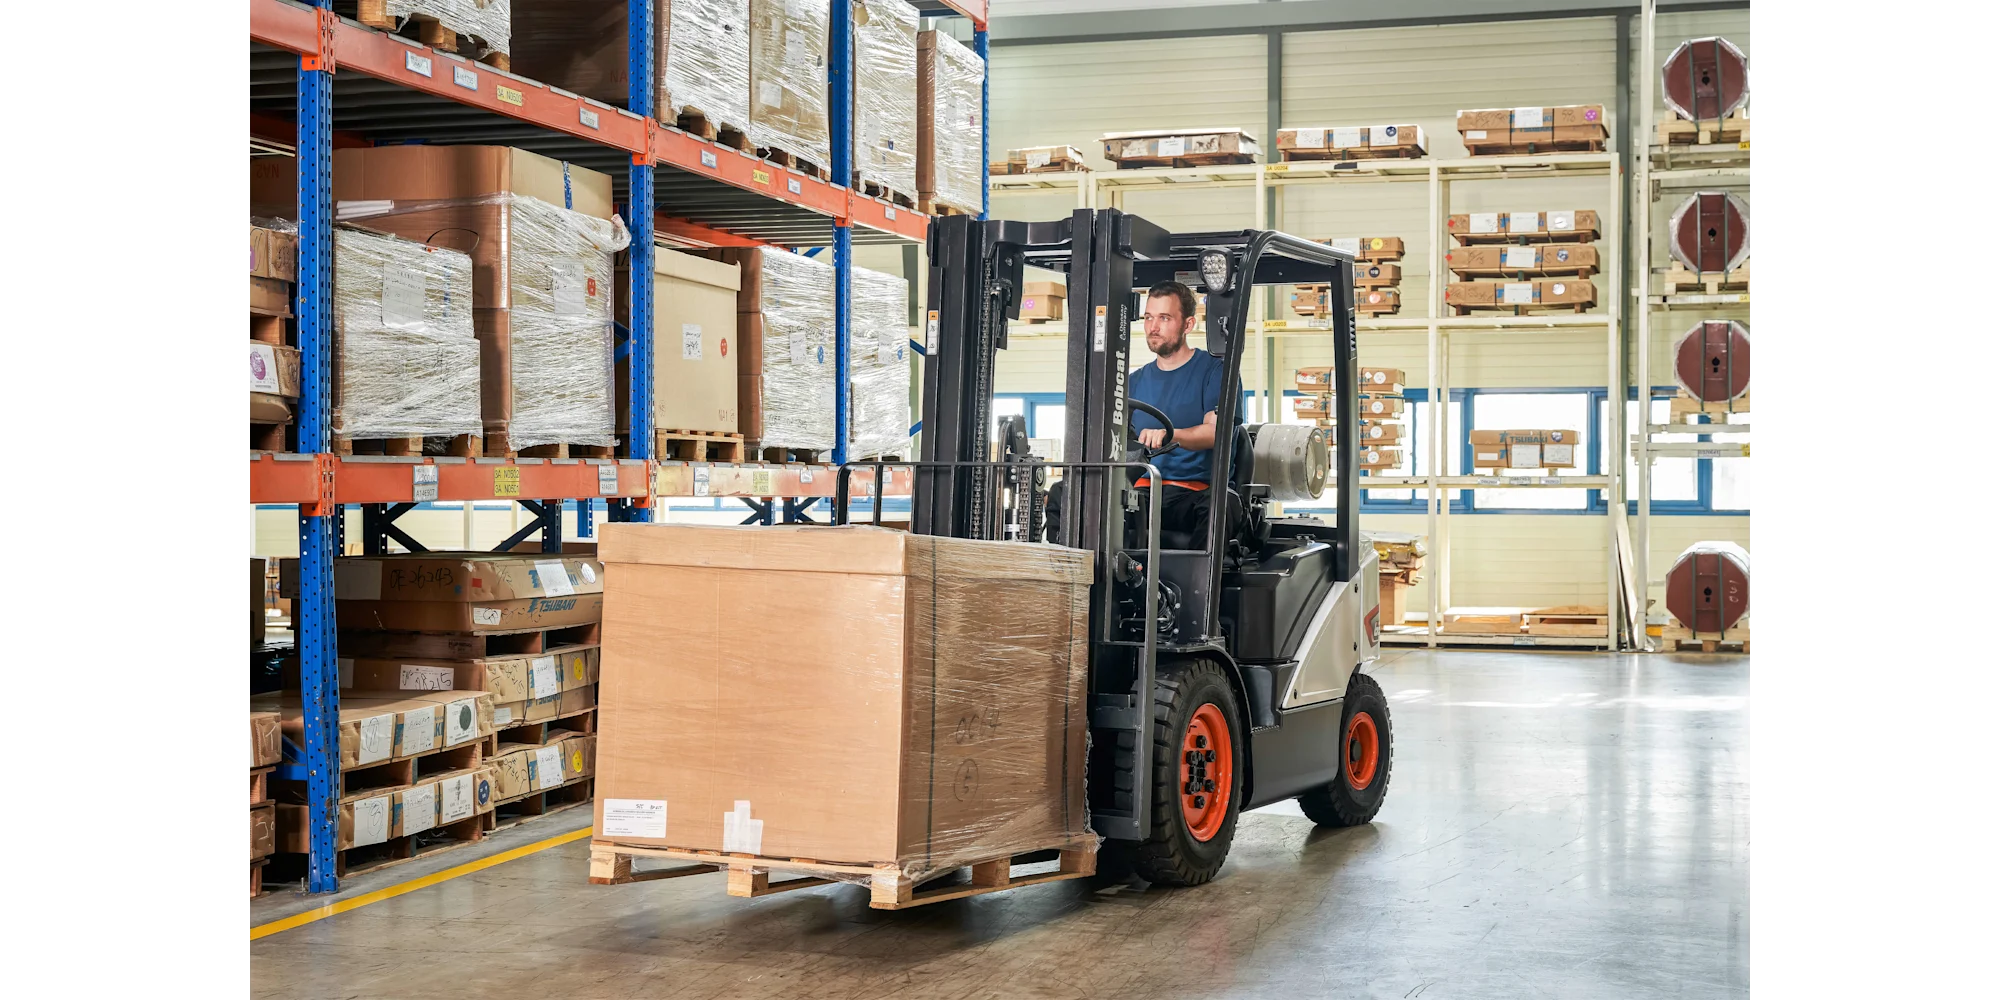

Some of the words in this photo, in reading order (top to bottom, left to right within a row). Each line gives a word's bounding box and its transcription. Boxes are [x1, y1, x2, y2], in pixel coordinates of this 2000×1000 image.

[497, 87, 505, 98] 3A
[1112, 350, 1126, 426] Bobcat
[1509, 435, 1548, 444] TSUBAKI
[494, 469, 502, 479] 3A
[494, 484, 502, 493] 3A
[539, 598, 578, 613] TSUBAKI
